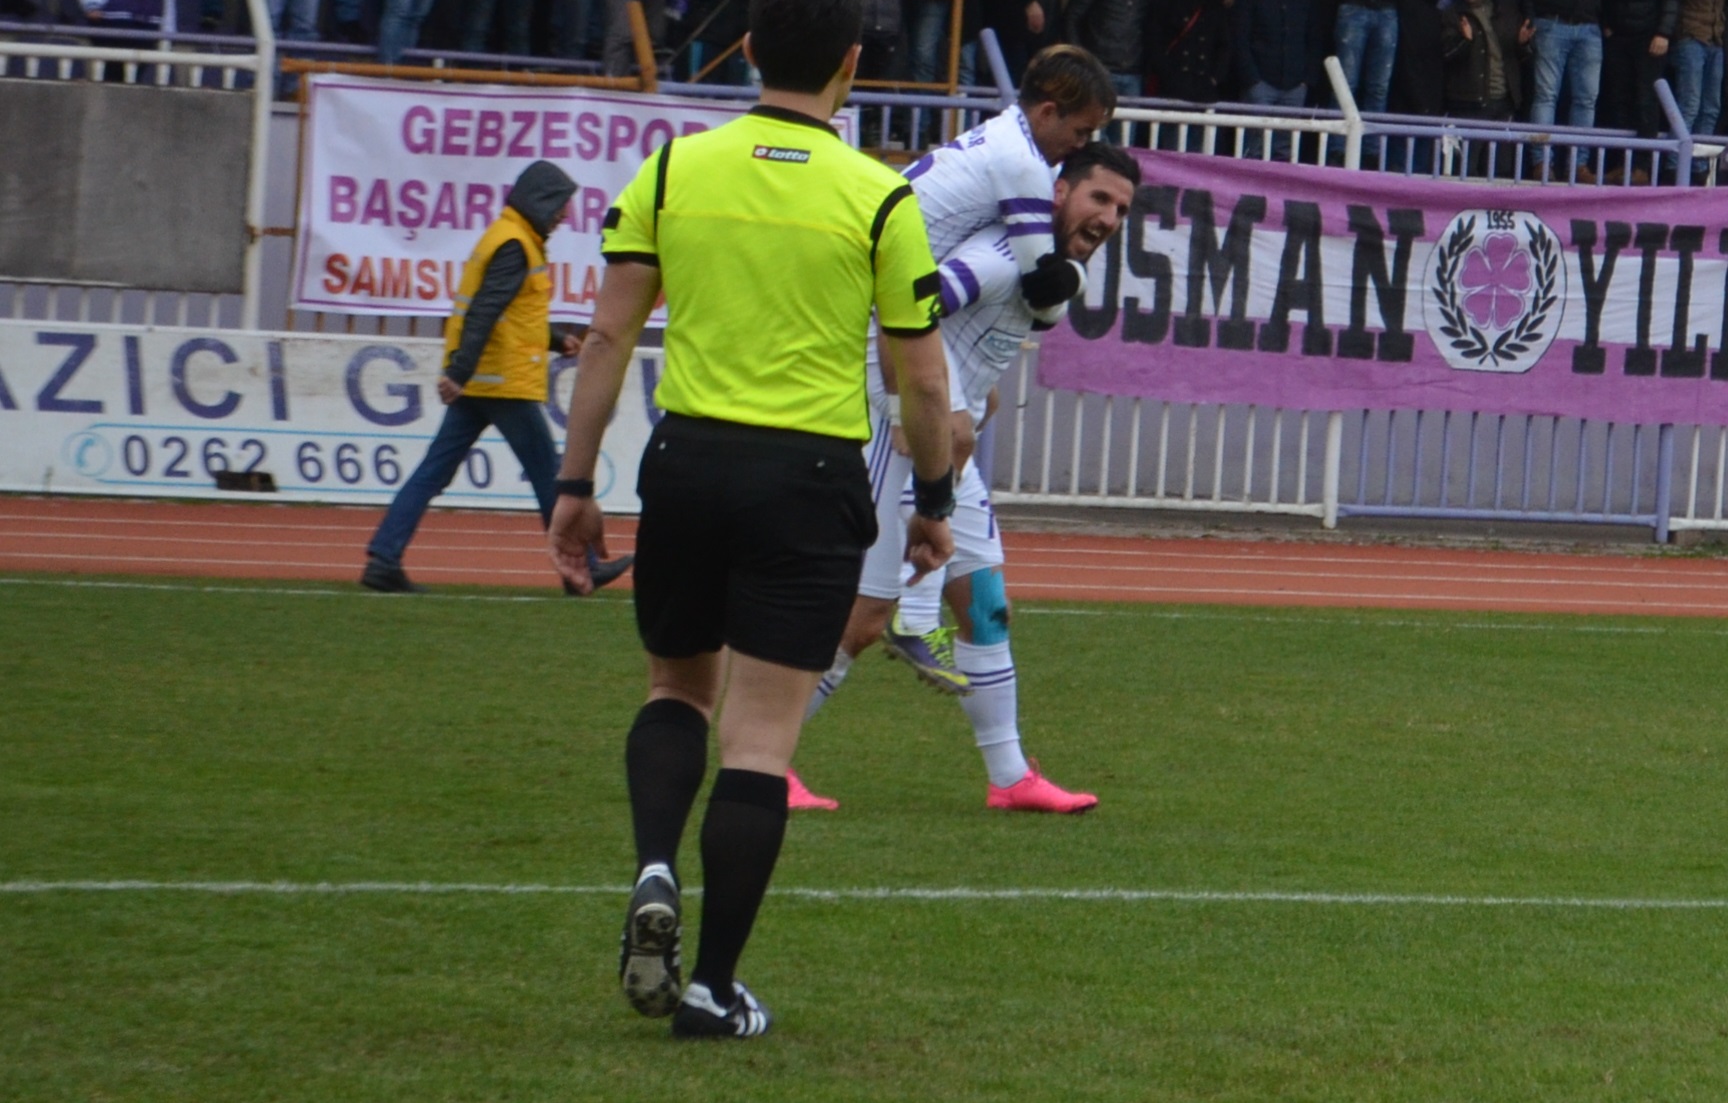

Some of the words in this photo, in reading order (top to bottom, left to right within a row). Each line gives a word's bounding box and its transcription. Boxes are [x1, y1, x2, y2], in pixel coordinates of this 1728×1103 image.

[1486, 210, 1516, 230] 1955
[124, 435, 267, 477] 0262
[298, 442, 401, 485] 666
